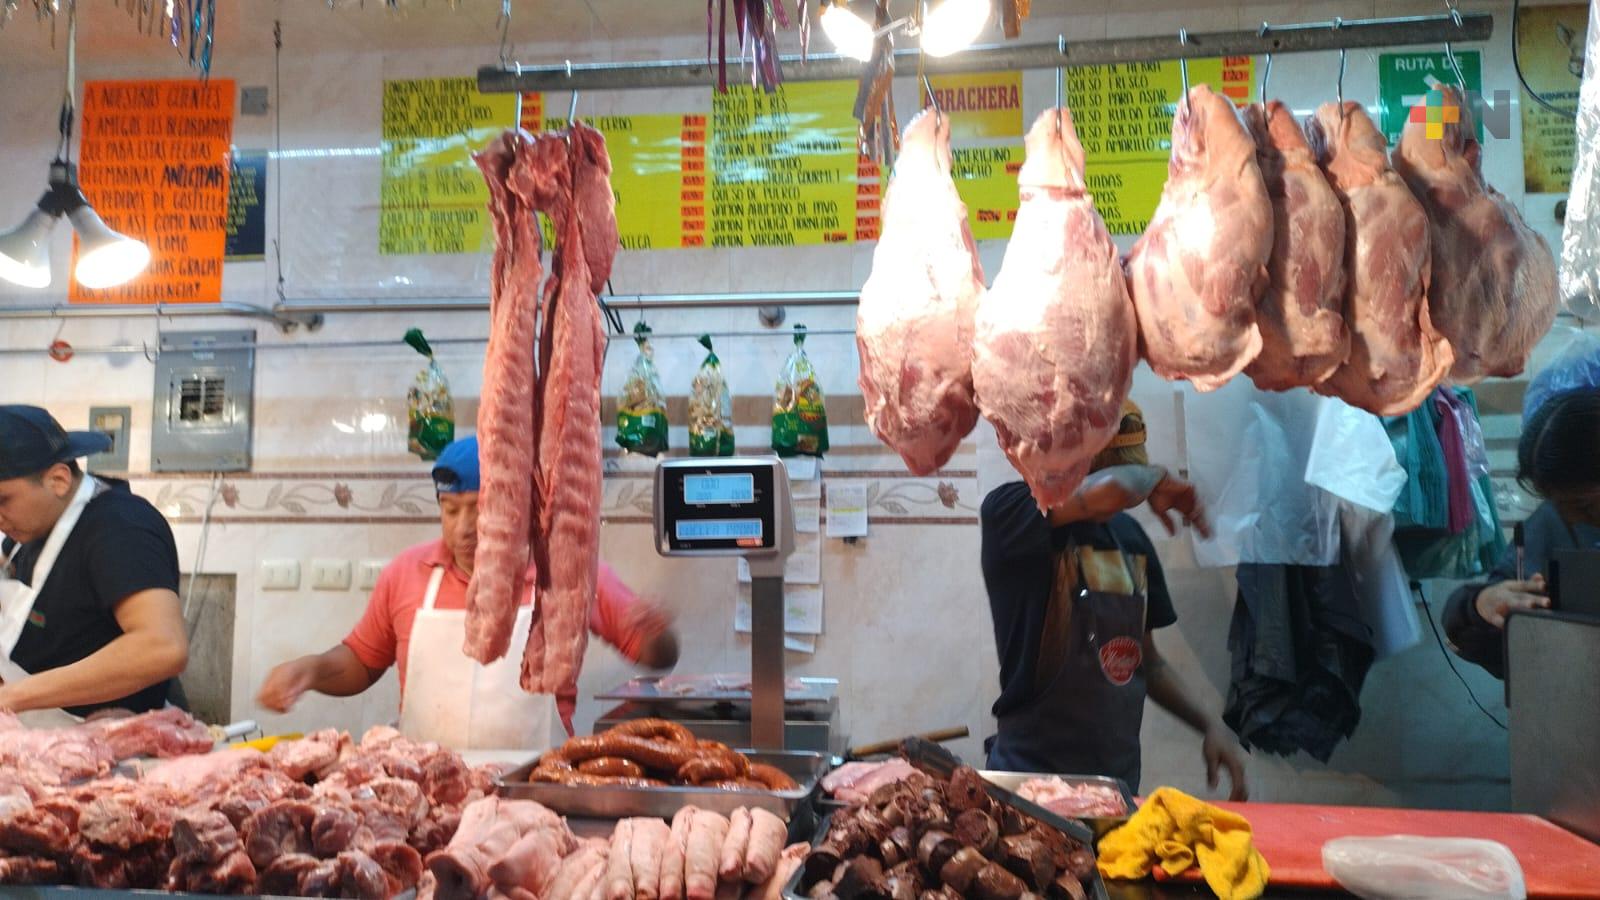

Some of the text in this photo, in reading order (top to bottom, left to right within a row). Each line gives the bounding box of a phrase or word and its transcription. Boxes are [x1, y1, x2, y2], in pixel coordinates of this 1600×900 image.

[1395, 56, 1463, 71] RUTA DE
[1067, 75, 1149, 93] QUESO FRESCO
[770, 94, 788, 113] RES
[924, 84, 1020, 112] ARRACHERA
[1067, 94, 1102, 108] QUESO
[1139, 89, 1168, 104] ASAR
[98, 116, 140, 137] AMIGOS
[1075, 125, 1102, 139] UESO
[1106, 137, 1155, 153] AMARILLO
[153, 191, 166, 209] DE
[712, 186, 743, 202] QUESO
[747, 187, 756, 201] DE
[763, 185, 801, 201] PUERCO
[712, 203, 744, 218] JAMON
[797, 201, 807, 216] DE
[813, 199, 838, 215] PAVO
[154, 215, 185, 232] COMO
[712, 218, 744, 233] JAMON
[157, 235, 188, 252] LOMO
[712, 234, 744, 249] JAMON
[750, 232, 796, 249] VIRGINIA
